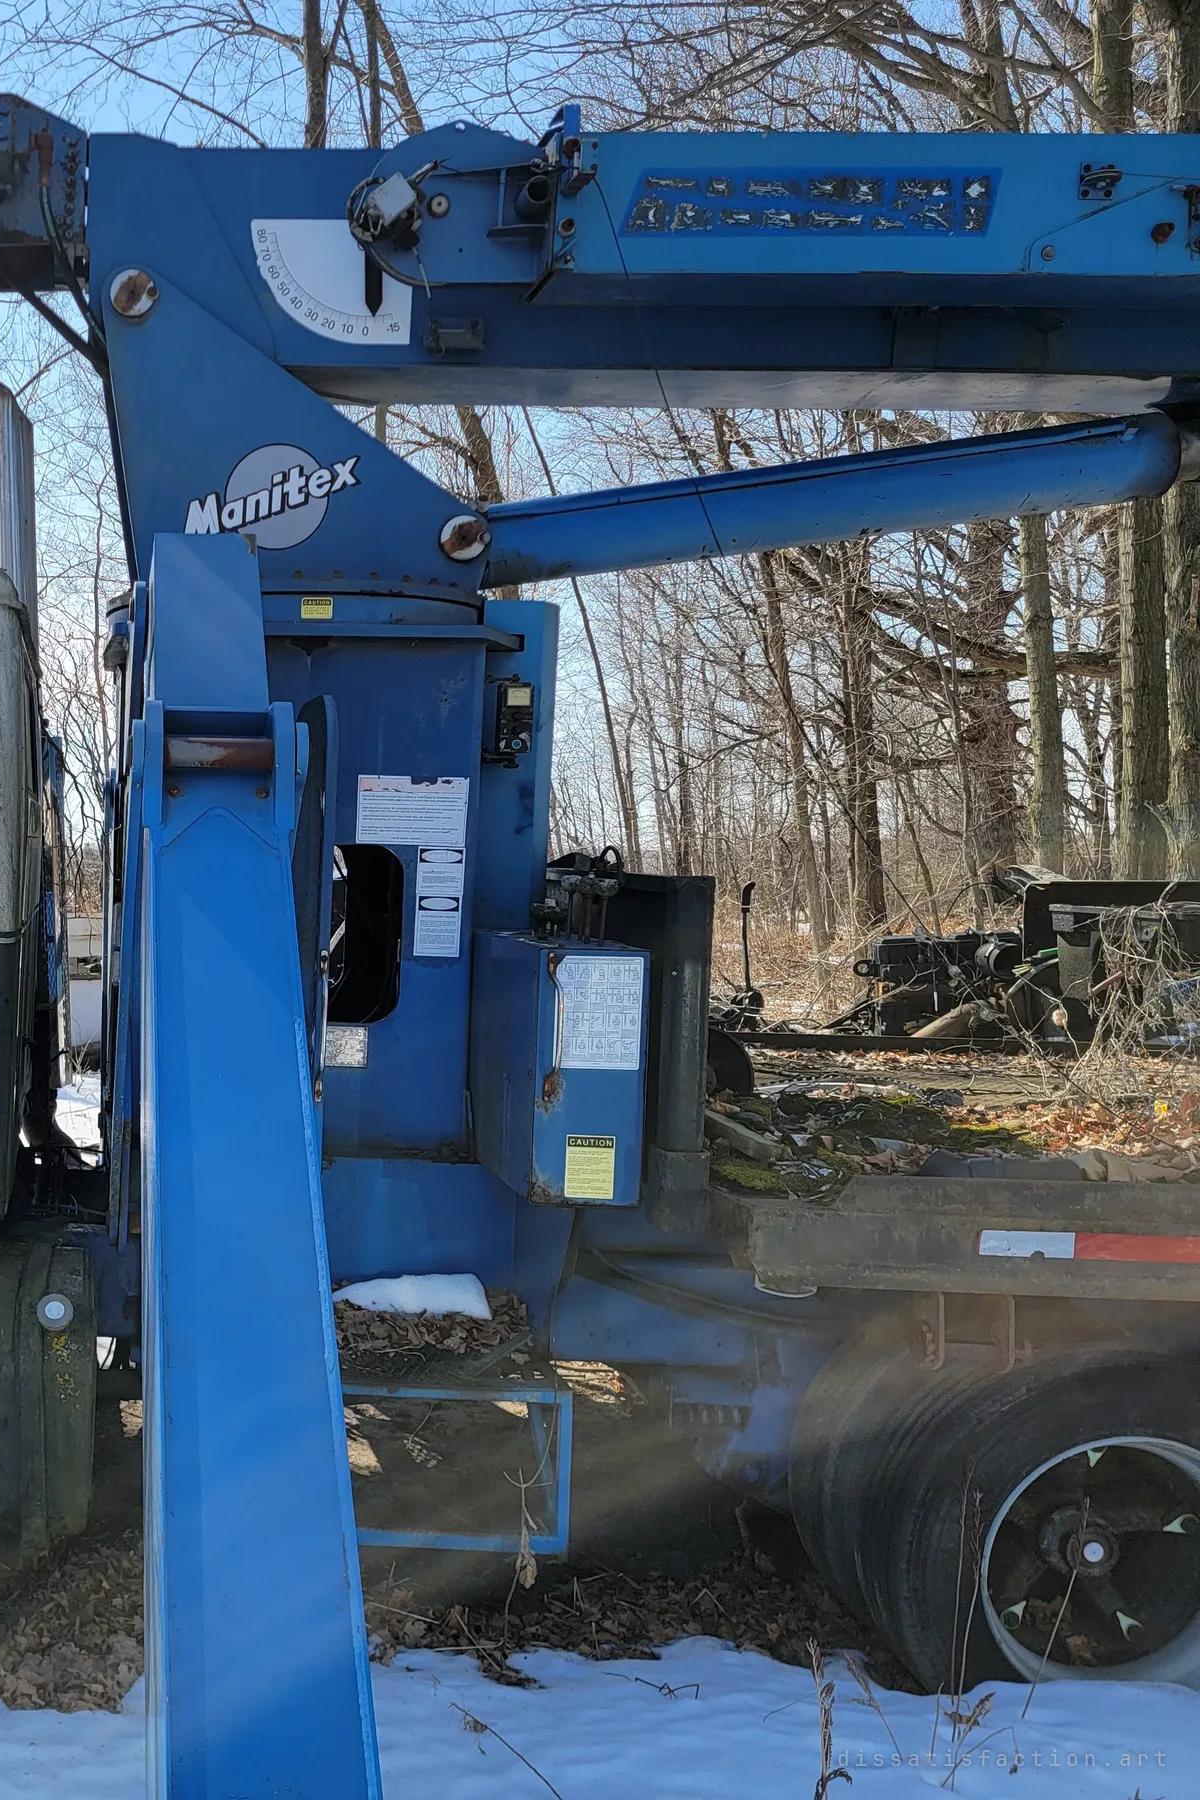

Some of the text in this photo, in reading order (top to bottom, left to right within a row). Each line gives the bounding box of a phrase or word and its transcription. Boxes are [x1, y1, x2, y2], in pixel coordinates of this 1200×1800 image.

[256, 228, 401, 336] 80 70 60 50 40 30 20 10 0 -15
[185, 455, 361, 534] Manitex
[569, 1138, 612, 1147] CAUTION
